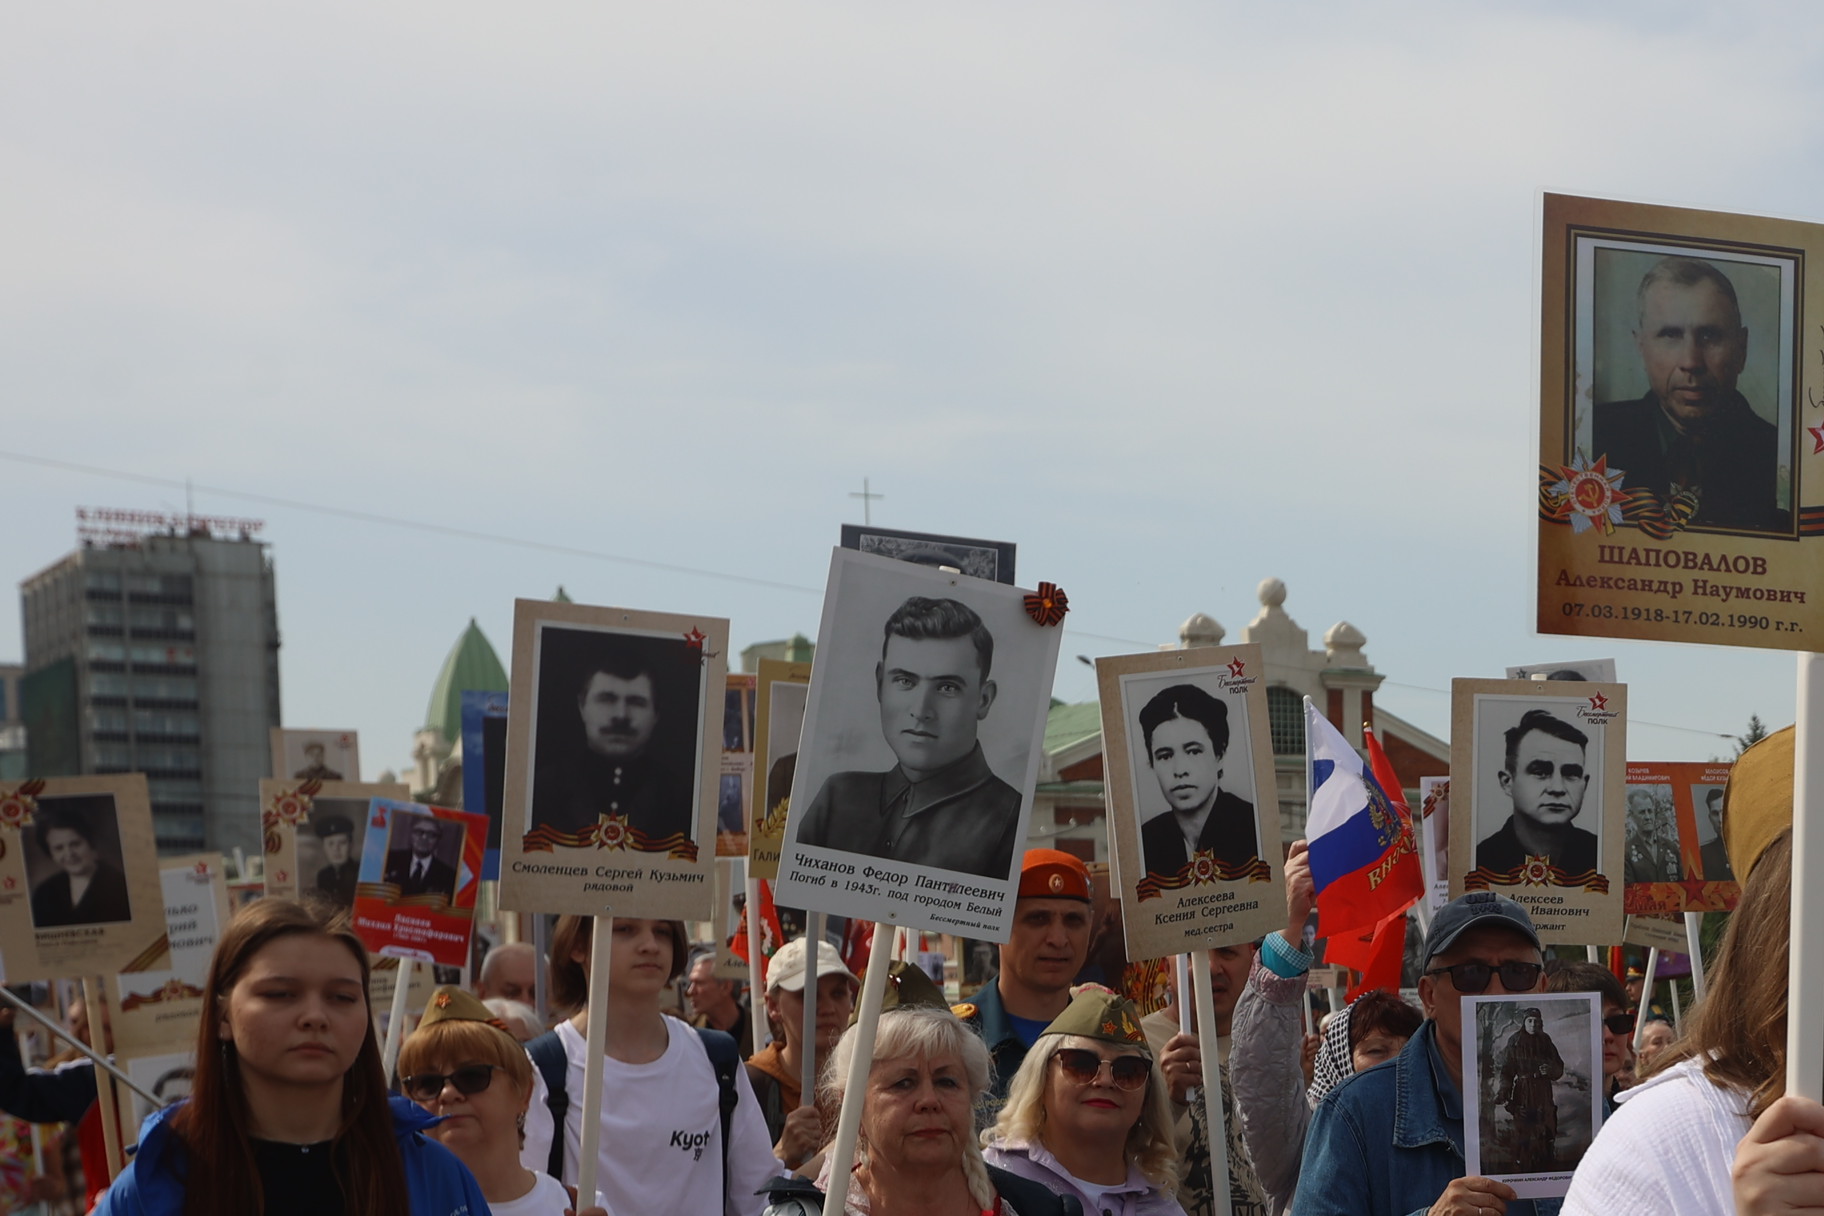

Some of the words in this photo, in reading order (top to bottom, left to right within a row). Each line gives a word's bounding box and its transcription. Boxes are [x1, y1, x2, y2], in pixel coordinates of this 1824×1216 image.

[1597, 545, 1767, 575] ШАПОВАЛОВ
[1555, 569, 1683, 599] Александр
[1692, 578, 1806, 603] Наумович
[1562, 602, 1769, 630] 07.03.1918-17.02.1990
[1775, 620, 1803, 632] г.г.
[1229, 686, 1248, 694] ПОЛК
[512, 861, 588, 876] Смоленцев
[595, 866, 643, 879] Сергей
[649, 869, 704, 883] Кузьмич
[794, 853, 855, 875] Чиханов
[862, 866, 908, 886] Федор
[583, 882, 634, 892] рядовой
[790, 871, 825, 886] Погиб
[831, 879, 838, 888] в
[844, 880, 881, 896] 1943г.
[887, 890, 909, 902] под
[914, 894, 961, 910] городом
[966, 902, 1003, 917] Белый
[1177, 891, 1235, 908] Алексеева
[1509, 894, 1564, 904] Алексеев
[1155, 910, 1195, 925] Ксения
[1201, 901, 1259, 918] Сергеевна
[1530, 906, 1589, 916] Иванович
[930, 913, 981, 929] Бессмертный
[983, 924, 1001, 932] полк
[1184, 922, 1234, 937] мед.сестра
